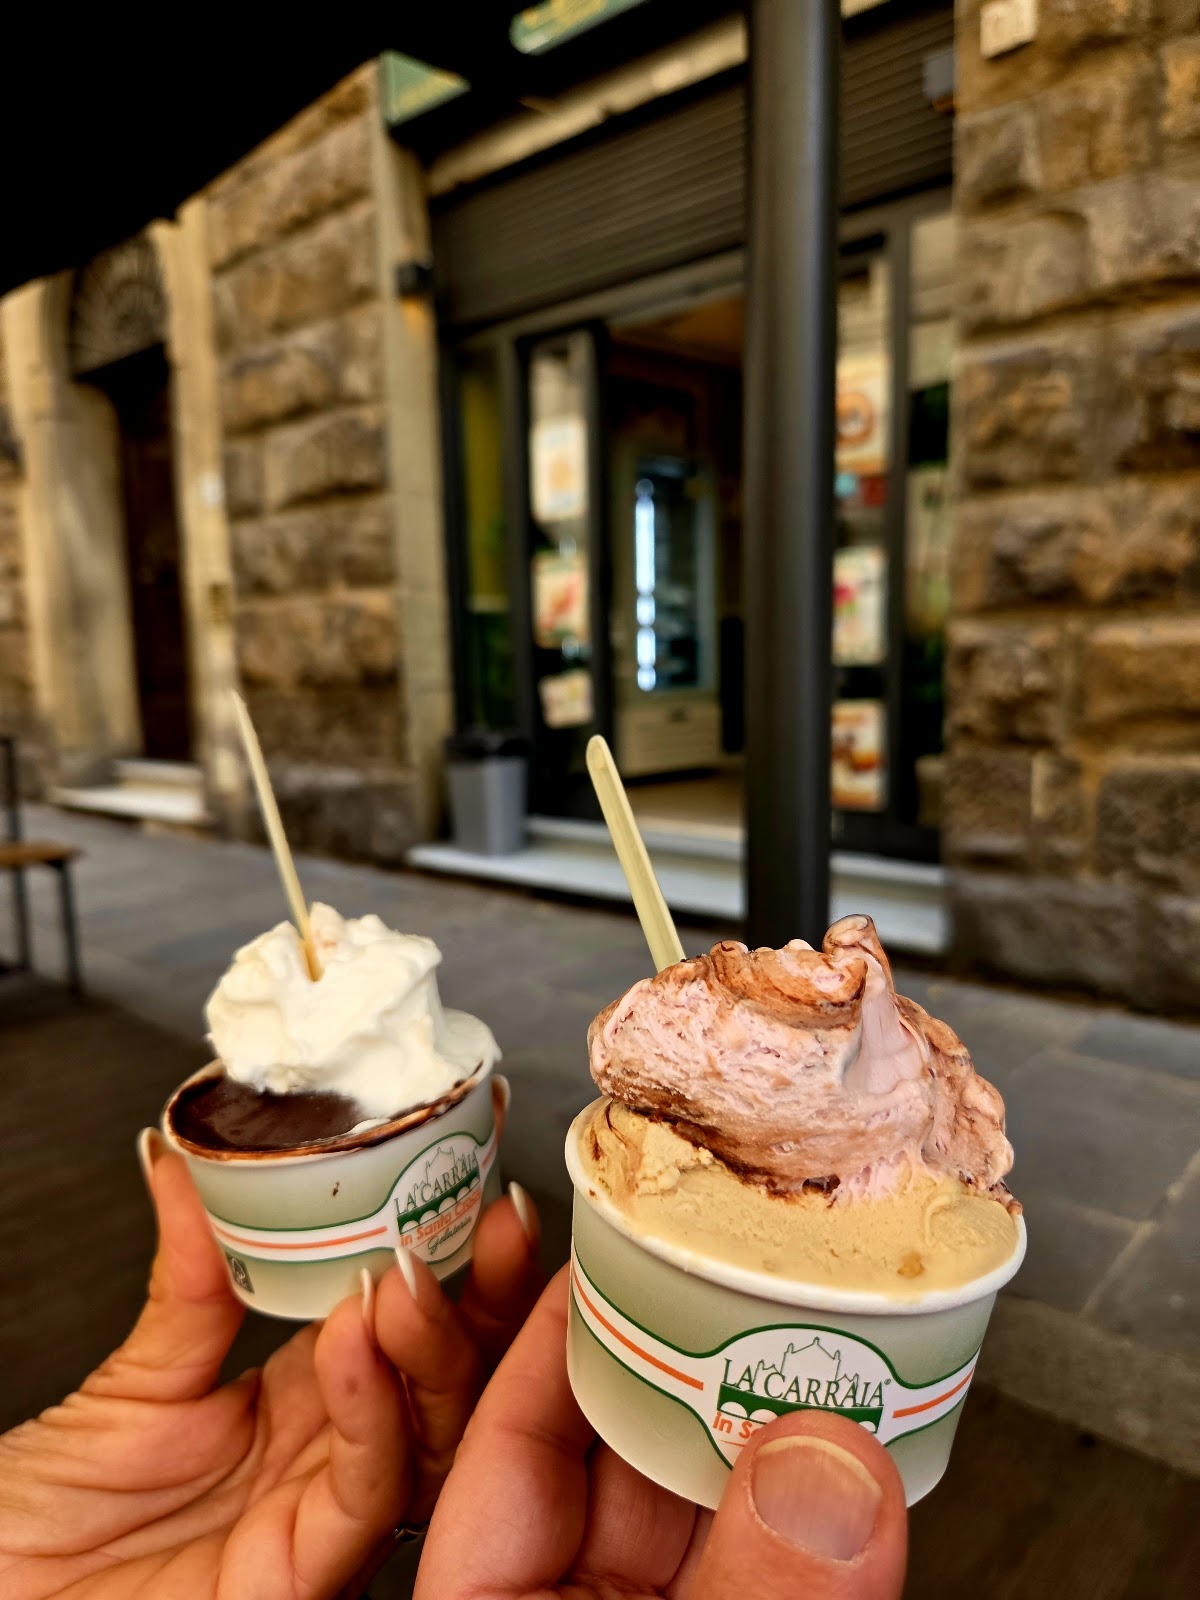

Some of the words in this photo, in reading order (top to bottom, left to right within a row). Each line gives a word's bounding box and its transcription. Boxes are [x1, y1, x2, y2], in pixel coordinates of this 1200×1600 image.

[394, 1192, 418, 1216] LA
[421, 1150, 479, 1203] CARRAIA
[400, 1234, 413, 1246] in
[416, 1211, 452, 1240] Santa
[722, 1358, 756, 1393] LA
[763, 1371, 885, 1408] CARRAIA
[712, 1411, 733, 1434] in
